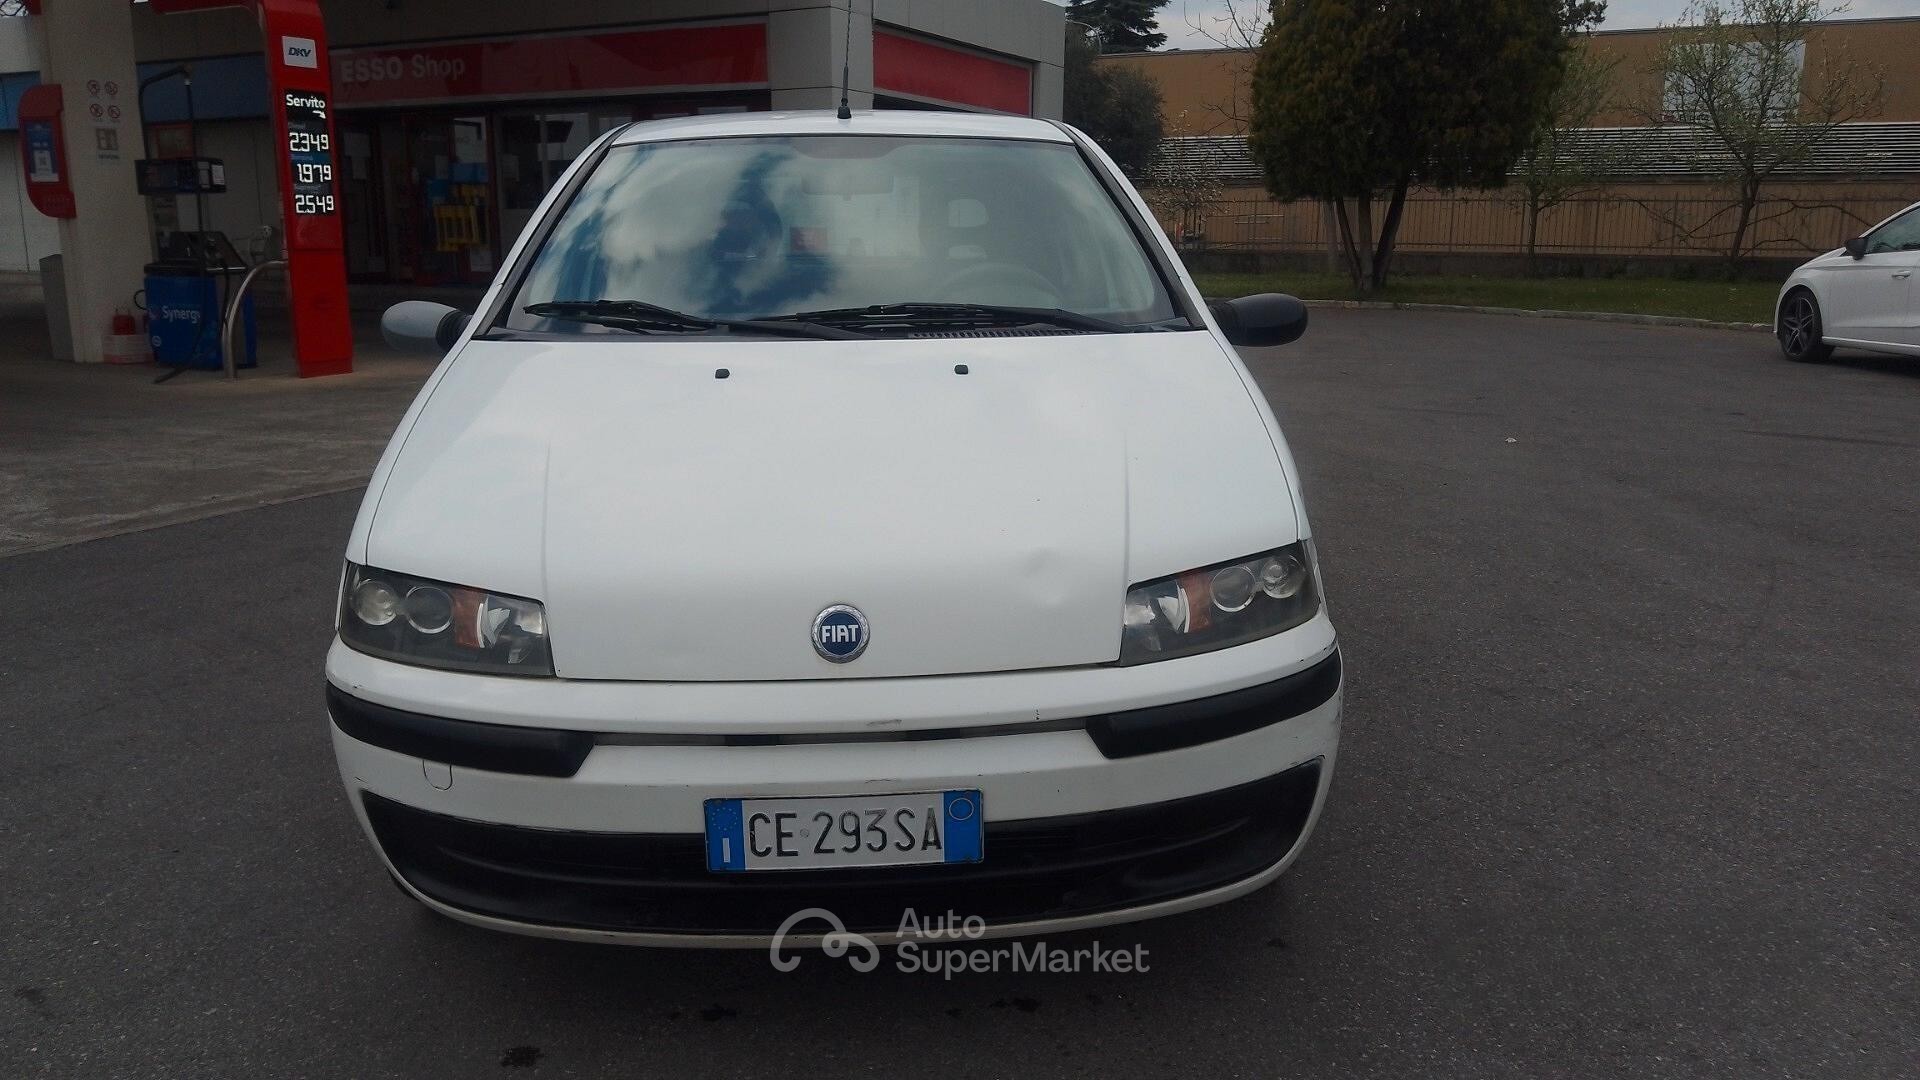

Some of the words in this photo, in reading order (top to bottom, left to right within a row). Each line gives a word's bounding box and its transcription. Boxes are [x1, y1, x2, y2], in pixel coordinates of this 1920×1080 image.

[288, 46, 311, 58] DKV
[341, 57, 401, 83] ESSO
[412, 54, 464, 81] Shop
[286, 94, 326, 109] Servito
[821, 624, 858, 643] FIAT
[748, 812, 799, 857] CE
[812, 807, 942, 854] 293SA
